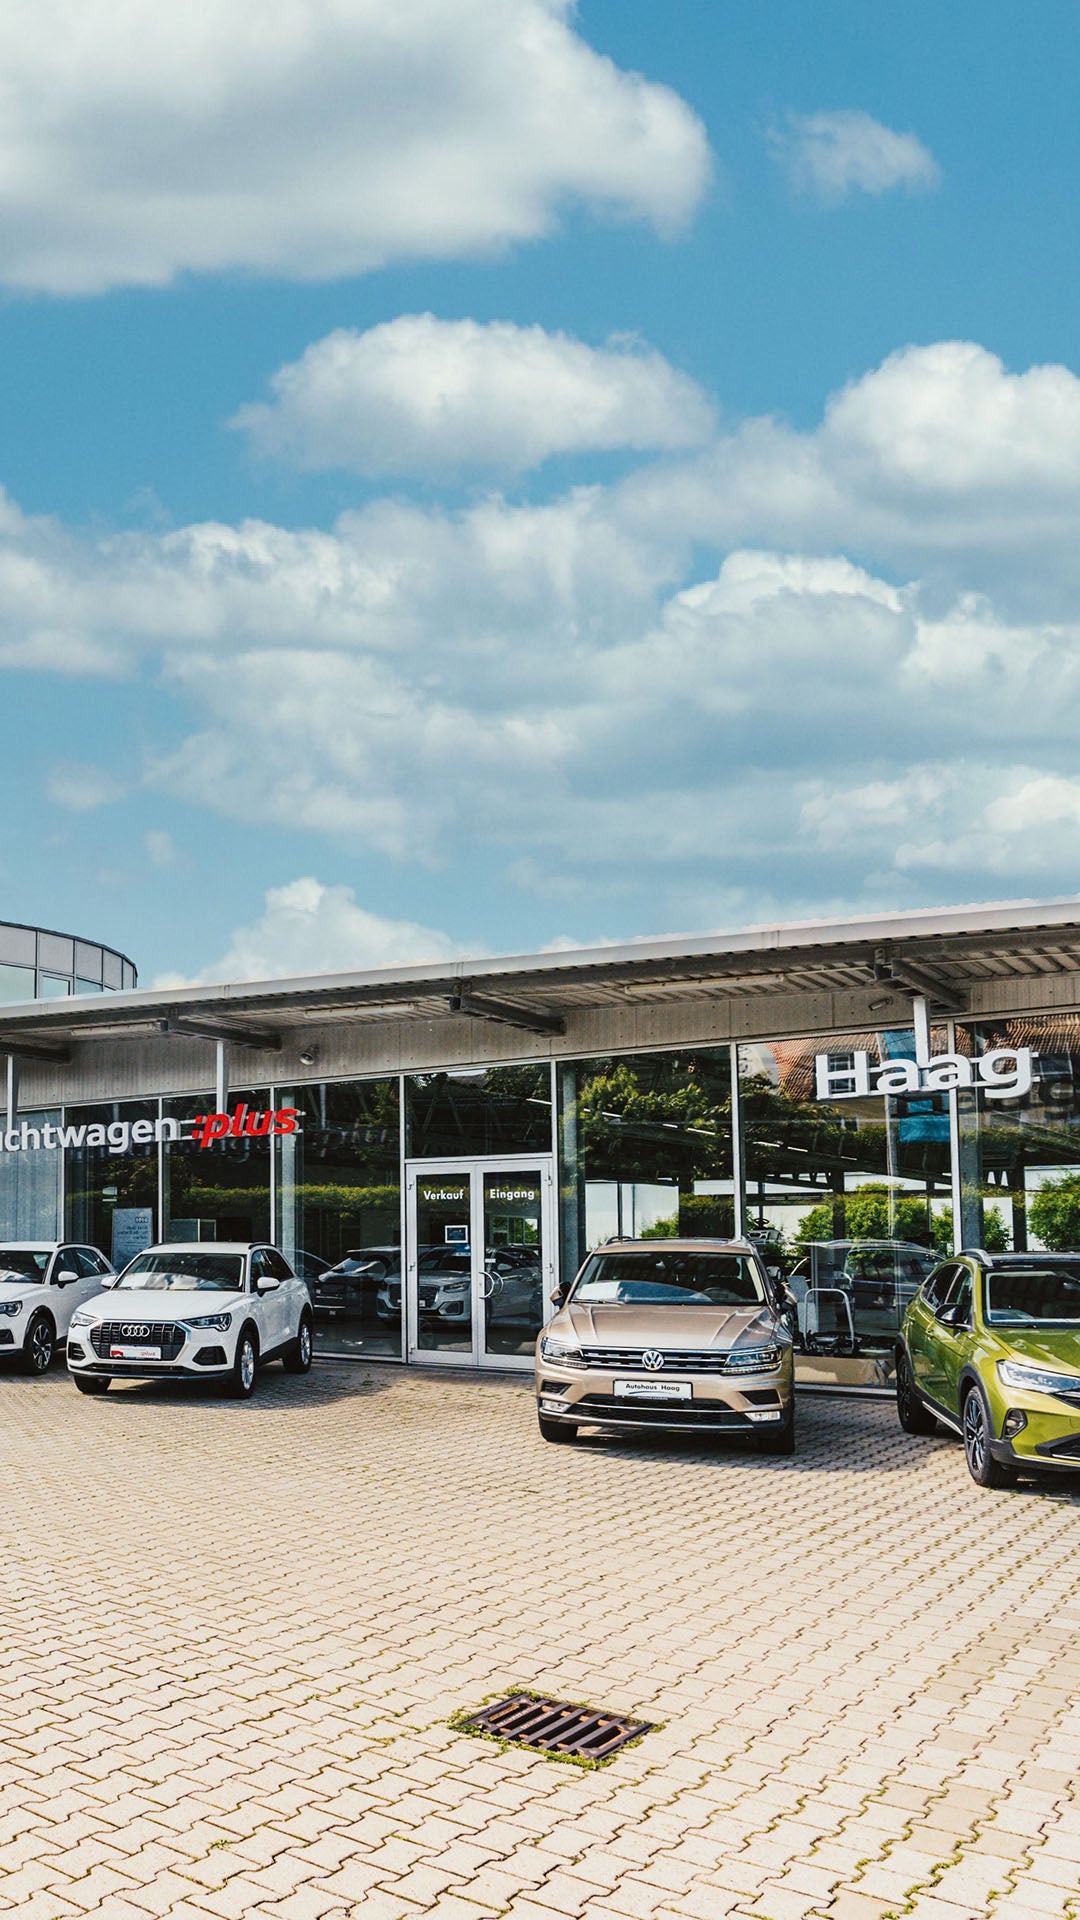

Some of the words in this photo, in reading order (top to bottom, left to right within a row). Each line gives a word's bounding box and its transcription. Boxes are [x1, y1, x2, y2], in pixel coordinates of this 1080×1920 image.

[816, 1047, 1033, 1100] Haag
[0, 1117, 179, 1153] chtwagen
[192, 1104, 298, 1147] :plus
[424, 1189, 464, 1200] Verkauf
[489, 1189, 535, 1200] Eingang
